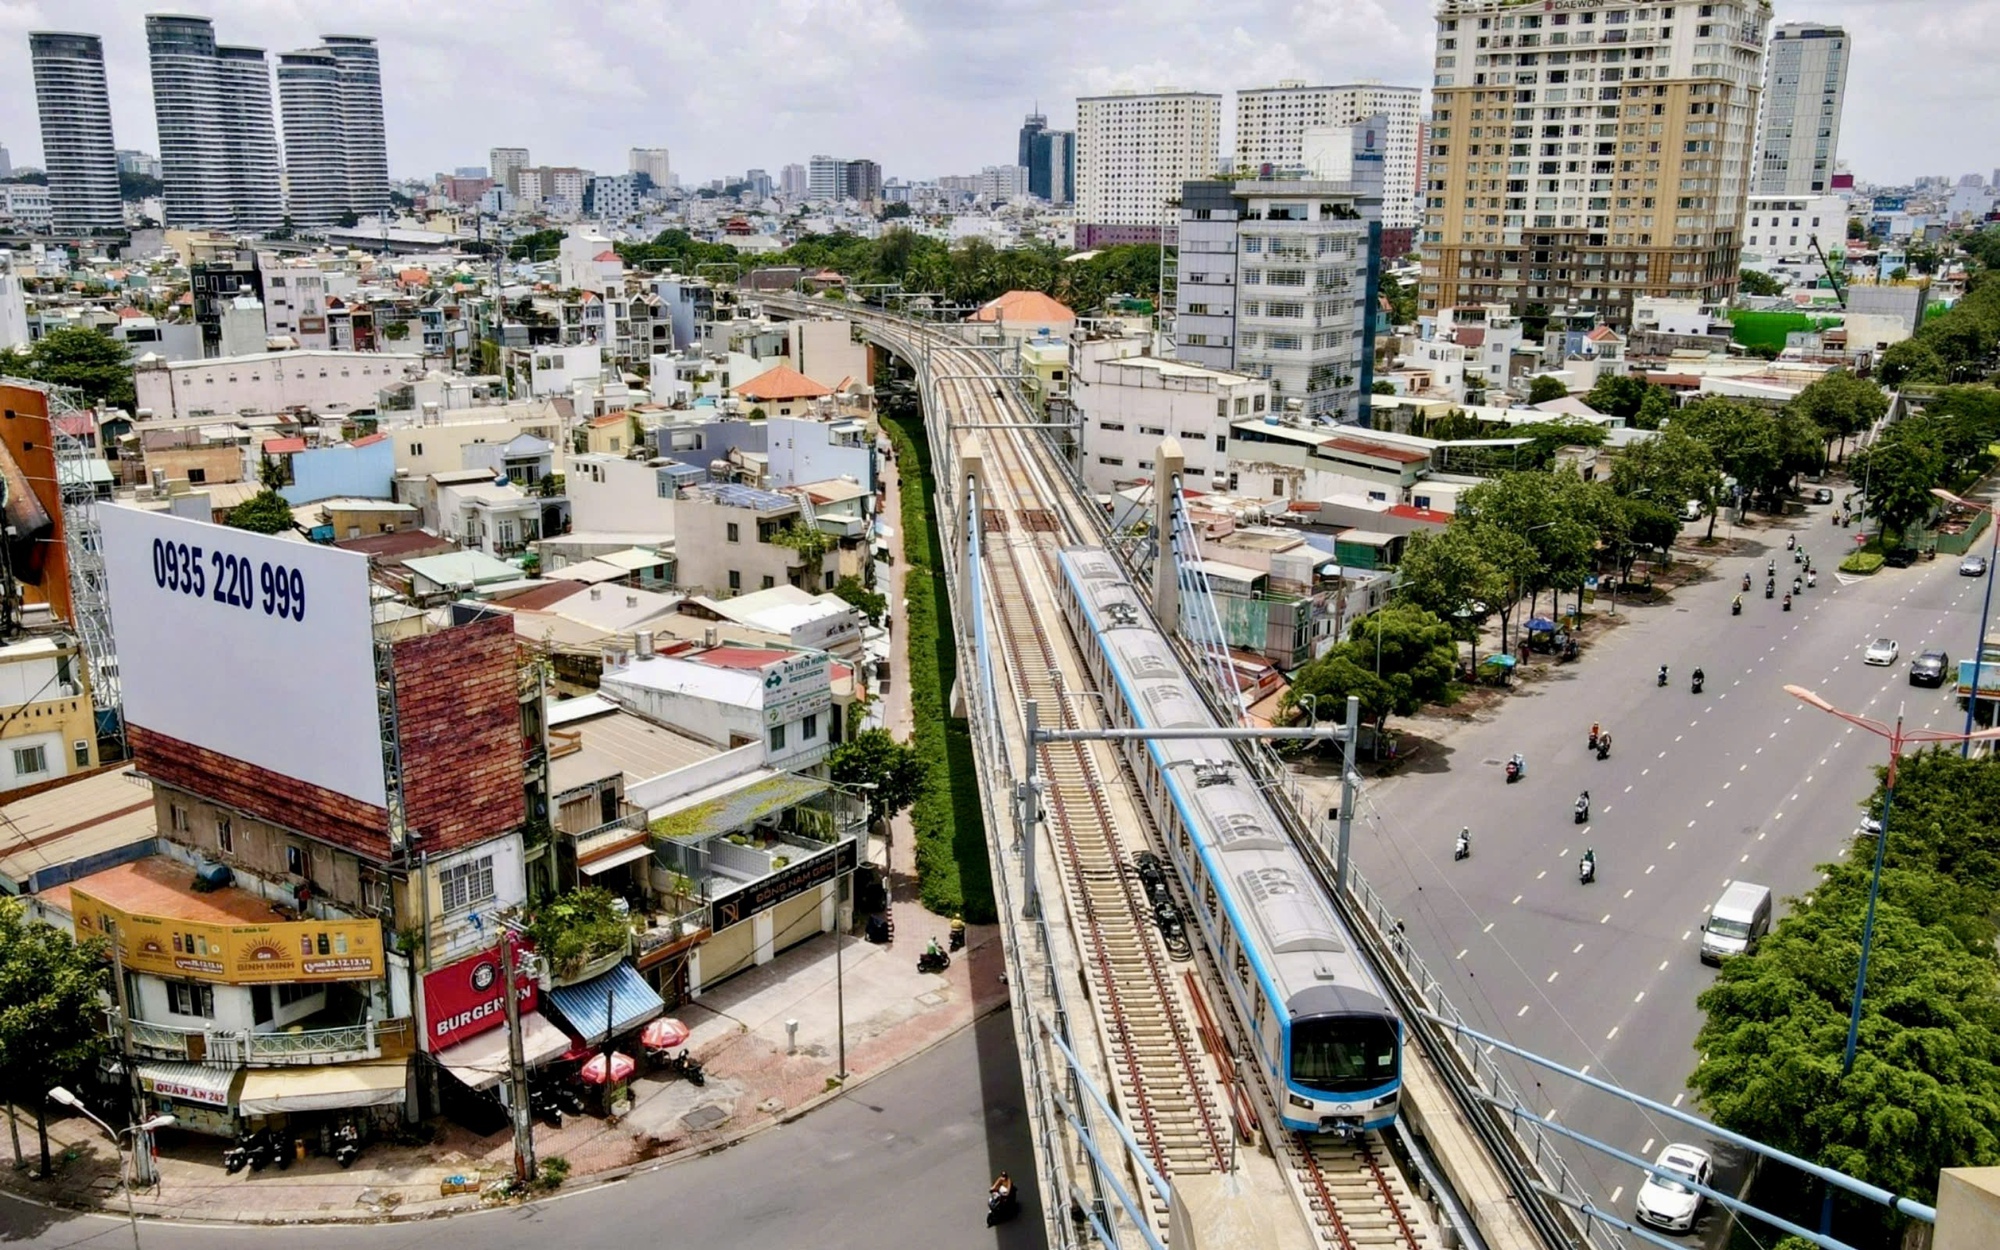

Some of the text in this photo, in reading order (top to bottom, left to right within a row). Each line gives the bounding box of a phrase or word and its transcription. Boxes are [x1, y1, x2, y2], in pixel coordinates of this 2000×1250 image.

[1555, 0, 1604, 9] DAEWON
[153, 538, 305, 622] 0935 220 999
[788, 873, 812, 888] NAM
